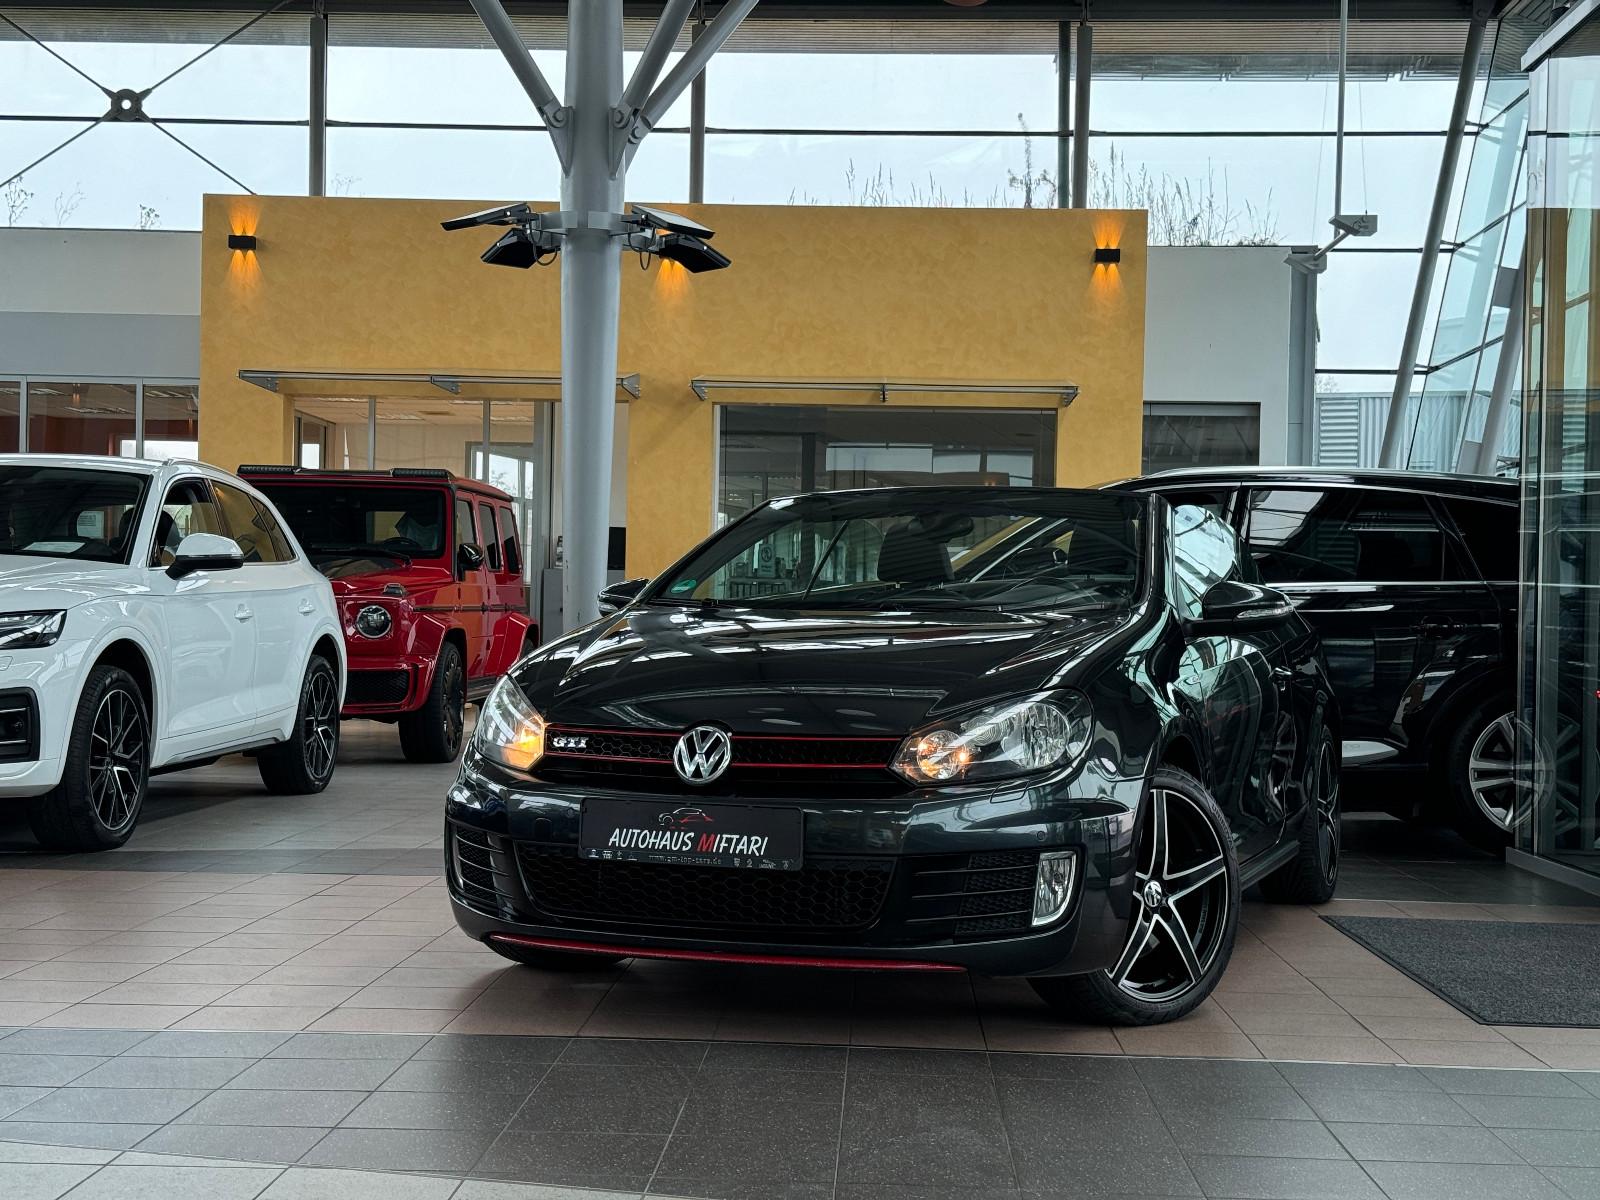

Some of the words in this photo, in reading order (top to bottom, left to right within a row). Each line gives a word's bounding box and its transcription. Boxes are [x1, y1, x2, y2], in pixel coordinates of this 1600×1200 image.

[552, 736, 588, 748] GTI
[608, 828, 694, 850] AUTOHAUS
[697, 833, 768, 856] MIFTARI
